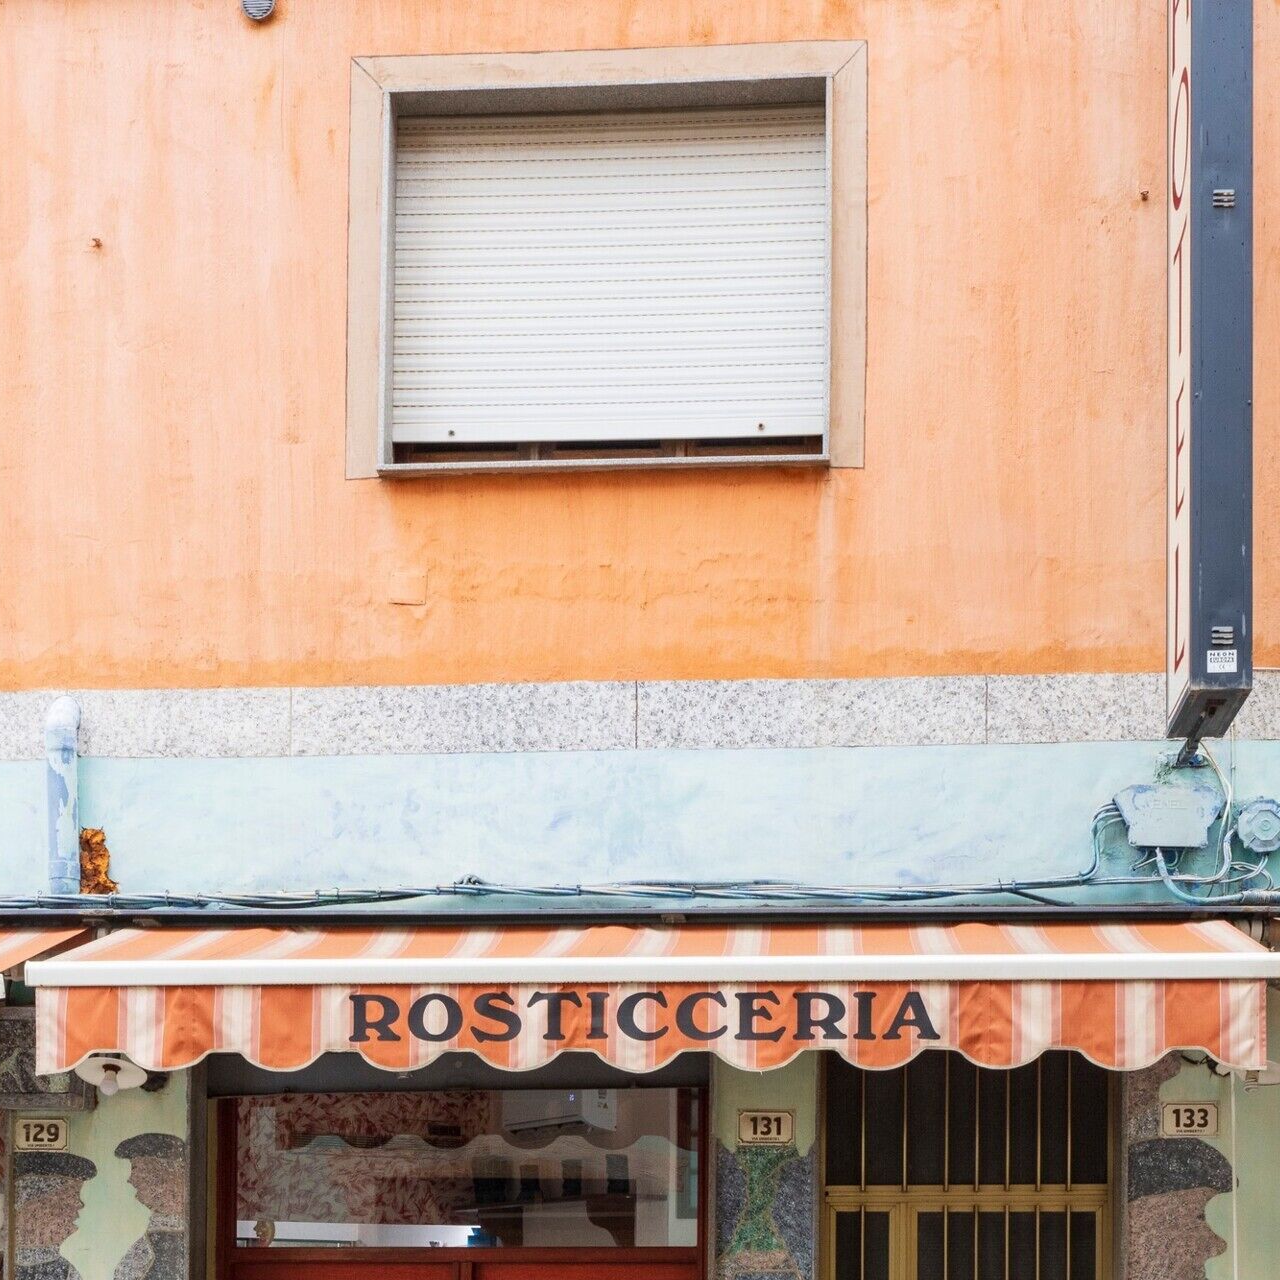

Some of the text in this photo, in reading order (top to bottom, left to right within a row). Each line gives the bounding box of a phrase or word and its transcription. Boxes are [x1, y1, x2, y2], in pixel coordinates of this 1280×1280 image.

[348, 990, 941, 1043] ROSTICCERIA
[749, 1116, 781, 1135] 131
[1172, 1108, 1208, 1128] 133
[23, 1123, 59, 1142] 129
